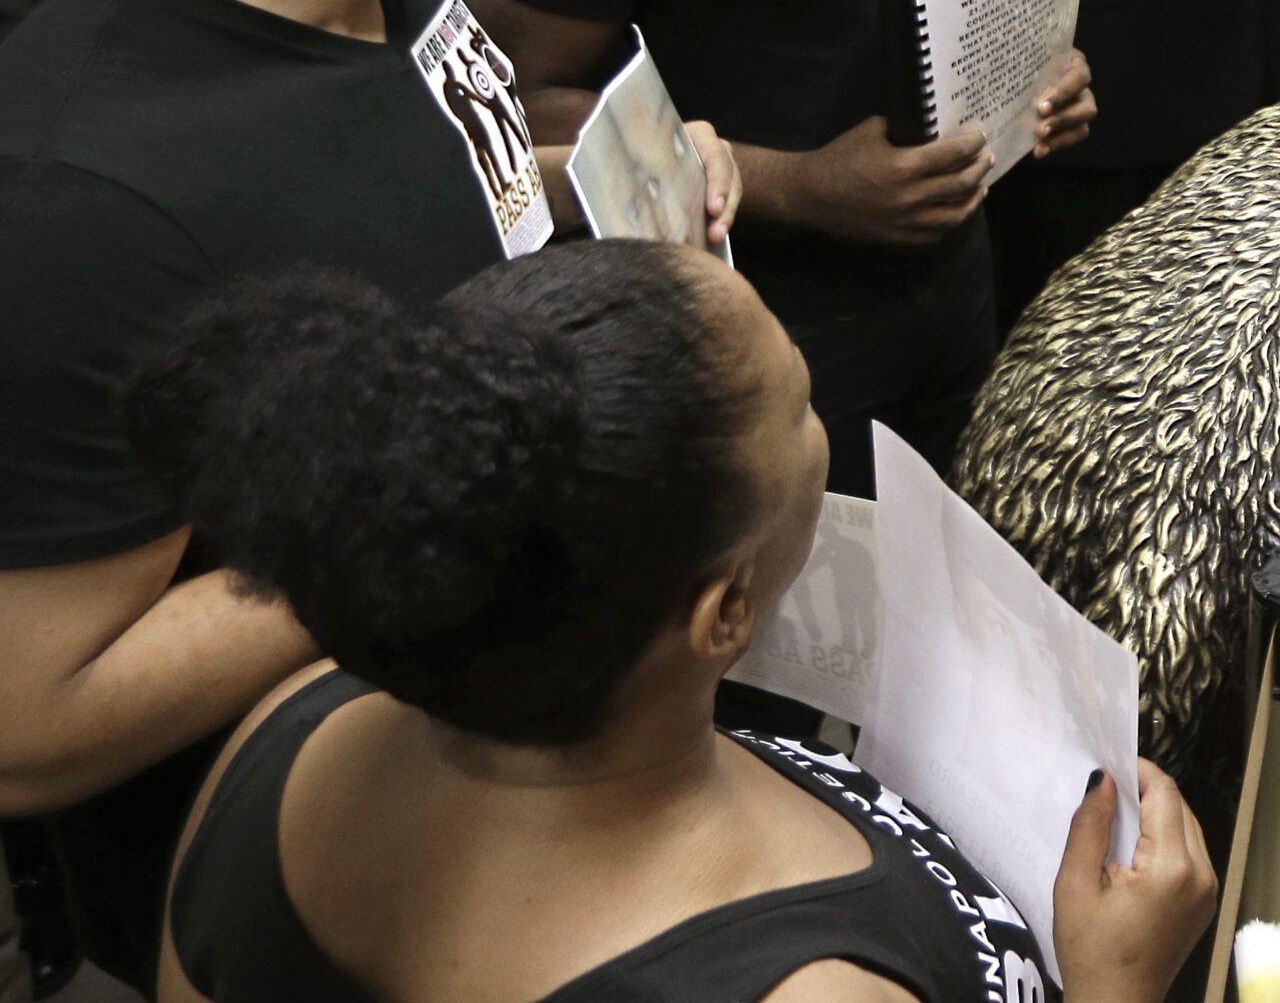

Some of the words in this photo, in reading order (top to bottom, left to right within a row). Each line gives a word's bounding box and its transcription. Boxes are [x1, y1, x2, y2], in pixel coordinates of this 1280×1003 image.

[959, 2, 1018, 44] RESPECTFULLY
[962, 34, 982, 53] THAT
[986, 8, 1027, 39] GOVERNOR
[967, 0, 1006, 30] COURAGE
[417, 47, 437, 76] WE
[426, 34, 447, 66] ARE
[951, 44, 981, 70] BROWN
[957, 38, 1008, 77] LEGISLATURE
[496, 177, 530, 236] PASS
